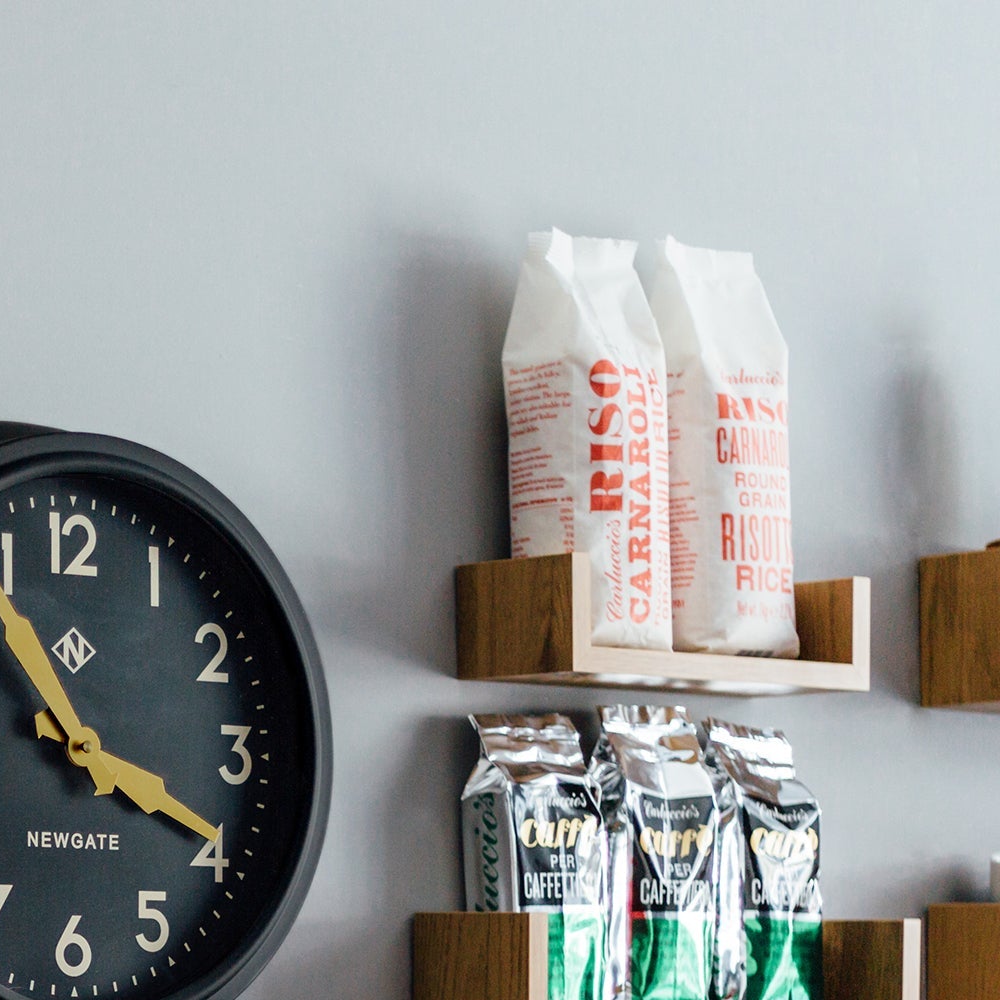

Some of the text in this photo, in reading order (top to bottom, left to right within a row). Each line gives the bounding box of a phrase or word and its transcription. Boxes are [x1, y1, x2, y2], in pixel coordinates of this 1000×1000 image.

[723, 368, 785, 385] arluccio's
[716, 393, 787, 426] RISO
[588, 359, 624, 623] Carluccio's RISO
[623, 364, 651, 624] CARNAROLI
[734, 472, 786, 491] ROUND
[739, 492, 787, 509] GRAIN
[49, 512, 97, 577] 12
[149, 546, 160, 607] 1
[736, 565, 792, 594] RICE
[194, 623, 229, 683] 2
[219, 725, 252, 785] 3
[26, 831, 120, 852] NEWGATE
[190, 823, 229, 883] 4
[550, 854, 576, 869] PER
[55, 915, 92, 977] 6
[135, 891, 169, 952] 5
